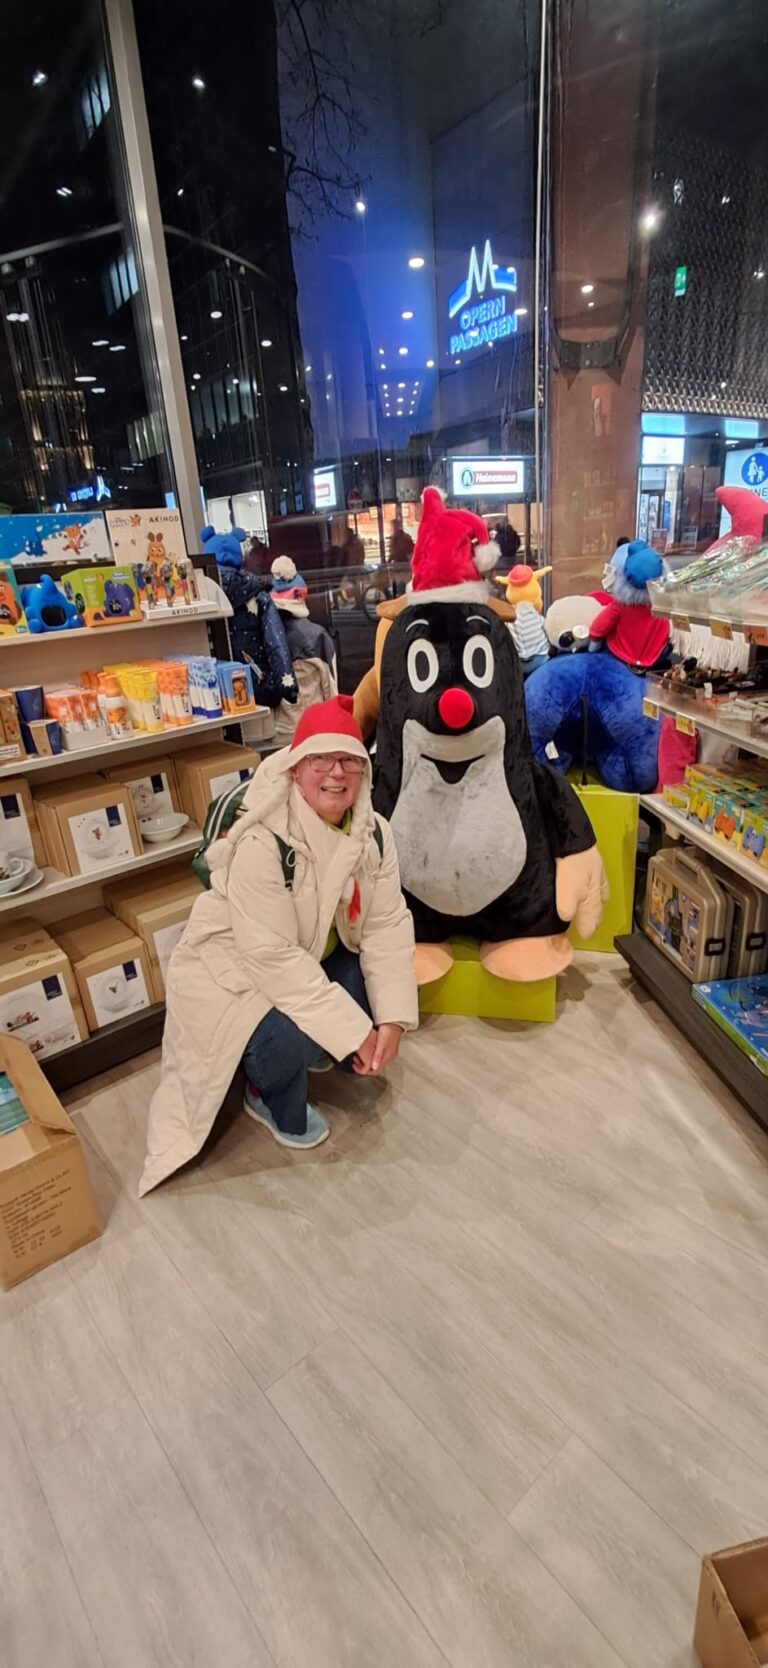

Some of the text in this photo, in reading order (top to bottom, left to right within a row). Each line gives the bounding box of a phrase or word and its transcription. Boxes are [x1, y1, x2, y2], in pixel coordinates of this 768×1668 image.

[460, 295, 506, 330] OPERN
[449, 313, 518, 355] PASSAGEN
[149, 515, 179, 523] AKINOD
[172, 607, 198, 615] AKINOD
